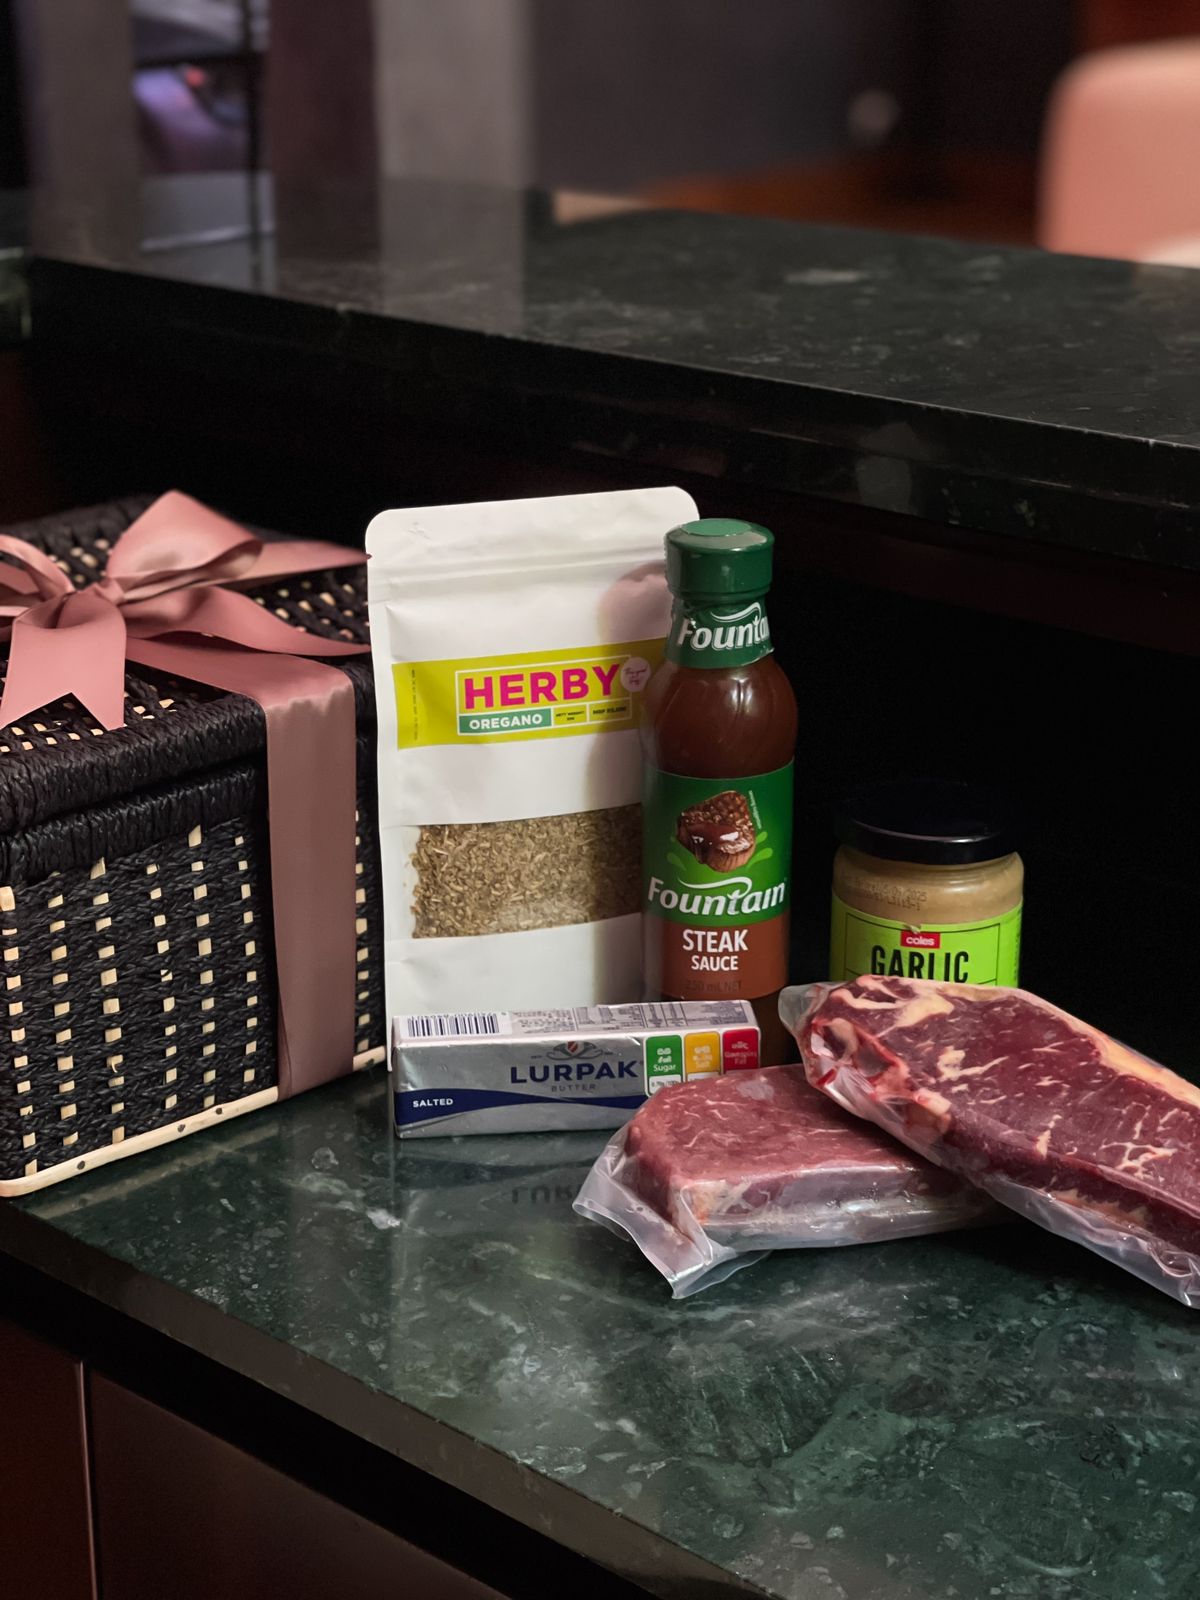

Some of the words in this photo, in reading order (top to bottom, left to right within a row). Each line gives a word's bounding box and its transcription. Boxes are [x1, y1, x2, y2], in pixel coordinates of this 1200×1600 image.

[464, 664, 620, 710] HERBY
[469, 713, 543, 730] OREGANO
[648, 876, 786, 916] Fountain
[682, 928, 748, 953] STEAK
[906, 936, 935, 946] coles
[691, 955, 738, 971] SAUCE
[511, 1060, 639, 1084] LURPAK
[653, 1064, 676, 1073] Sugar
[551, 1083, 597, 1092] BUTTER
[413, 1098, 454, 1108] SALTED
